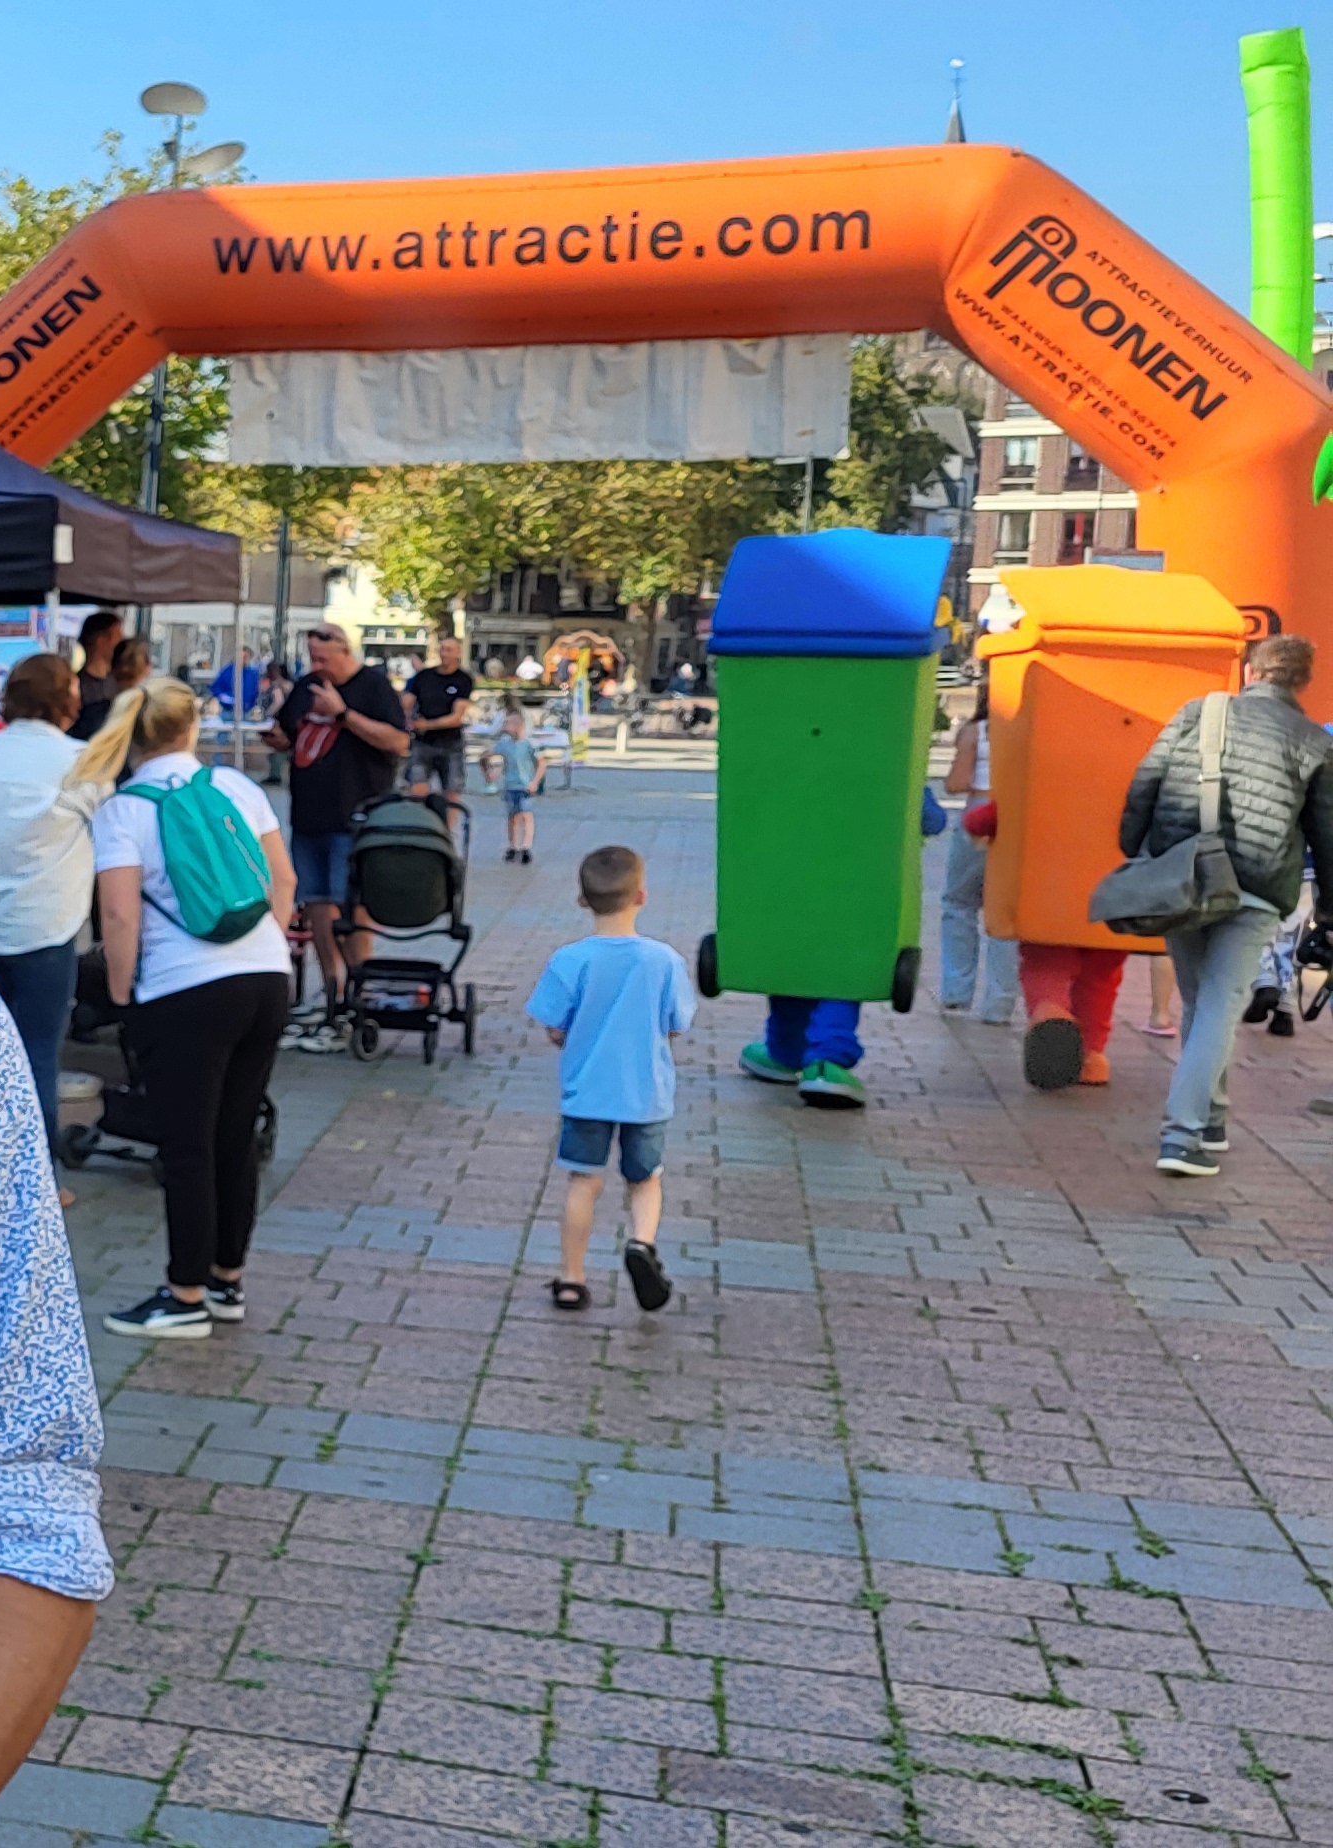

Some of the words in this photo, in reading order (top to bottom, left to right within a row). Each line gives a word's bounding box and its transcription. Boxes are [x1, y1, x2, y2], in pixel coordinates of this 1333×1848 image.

[212, 208, 871, 274] www.attractie.com
[1085, 250, 1254, 384] ATTRACTIEVERHUUR
[954, 287, 1165, 461] WWW.ATTRACTIE.COM
[983, 222, 1229, 421] MOONEN
